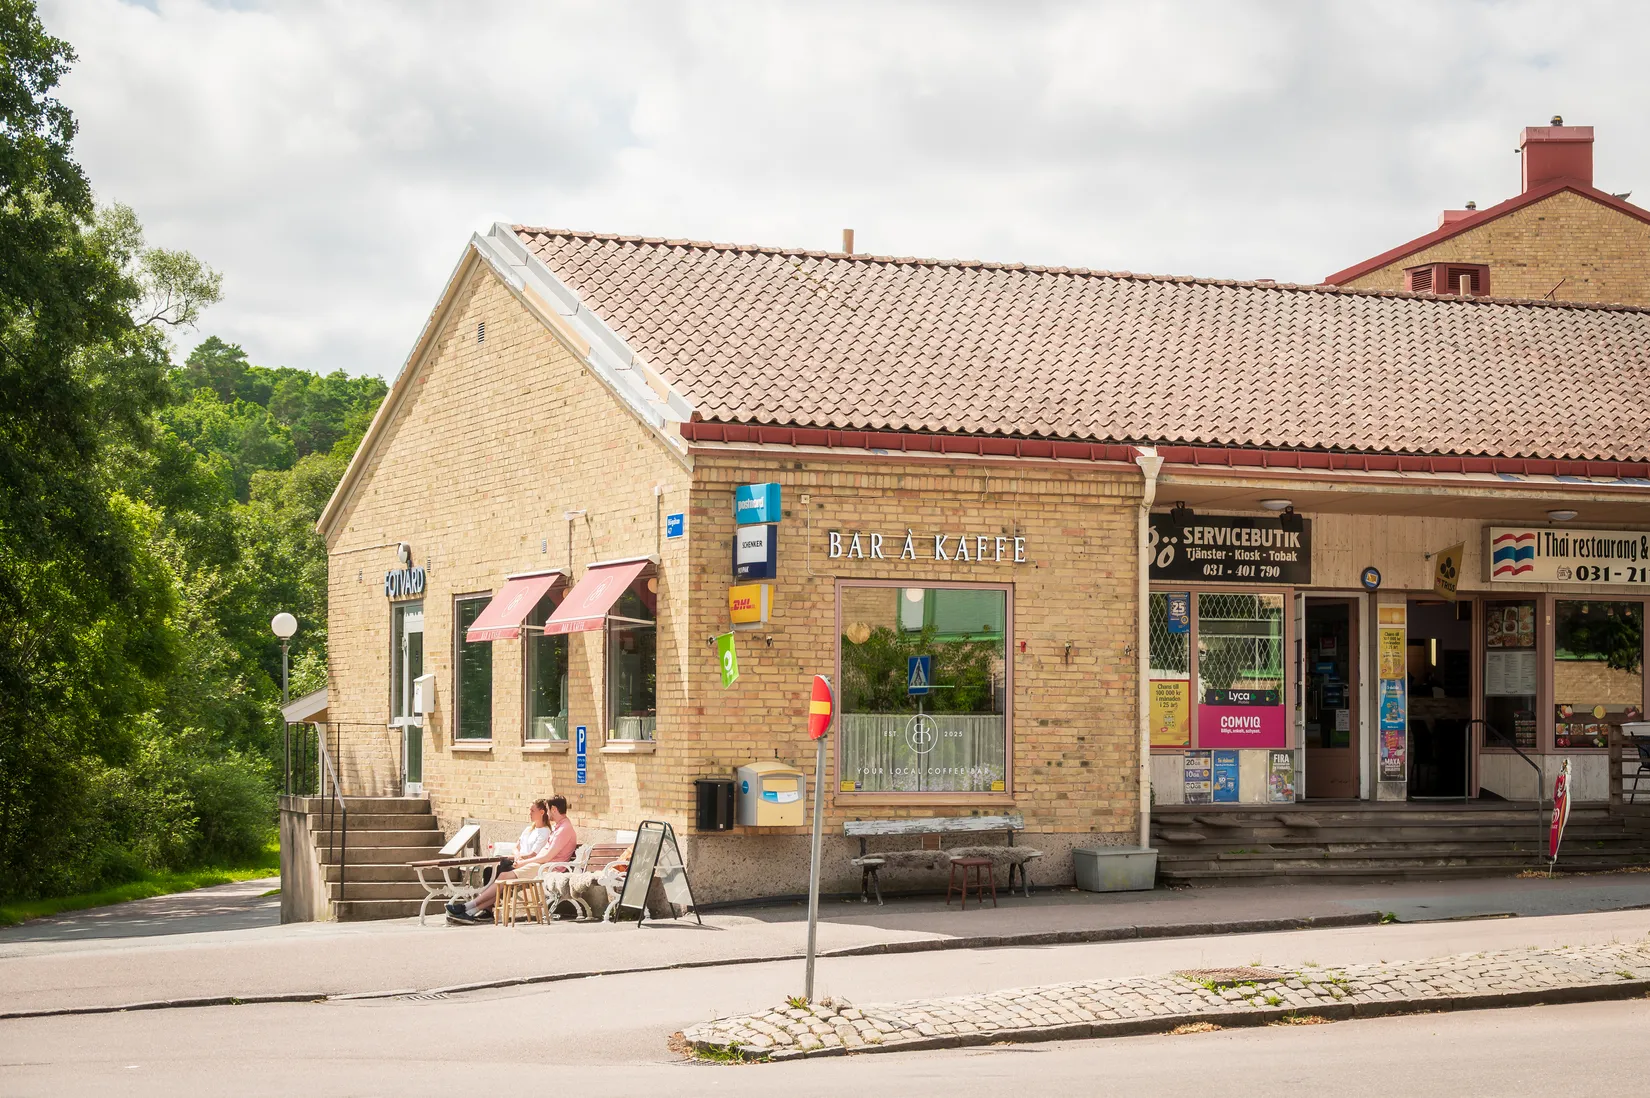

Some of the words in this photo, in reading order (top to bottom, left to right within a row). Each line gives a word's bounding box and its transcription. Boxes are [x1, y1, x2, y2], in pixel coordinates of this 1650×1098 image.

[737, 497, 764, 511] postnord
[1183, 526, 1301, 548] SERVICEBUTIK
[742, 540, 763, 549] SCHENKER
[829, 531, 884, 559] BAR
[900, 528, 916, 560] À
[934, 534, 1026, 563] KAFFE
[1544, 531, 1569, 558] Thai
[1572, 535, 1637, 562] restaurang
[1640, 535, 1649, 560] &
[1186, 547, 1226, 561] Tjänster
[1234, 551, 1260, 561] Kiosk
[1269, 550, 1298, 562] Tobak
[1203, 563, 1223, 576] 031
[1235, 564, 1256, 577] 401
[1260, 565, 1280, 578] 790
[1575, 565, 1610, 582] 031
[1626, 566, 1650, 583] 21
[1441, 579, 1455, 592] TRISS
[733, 598, 752, 611] DHL
[1172, 602, 1185, 613] 25
[1229, 691, 1250, 702] Lyca
[1221, 716, 1261, 728] COMVIQ
[578, 728, 585, 752] P
[1273, 754, 1289, 763] FIRA
